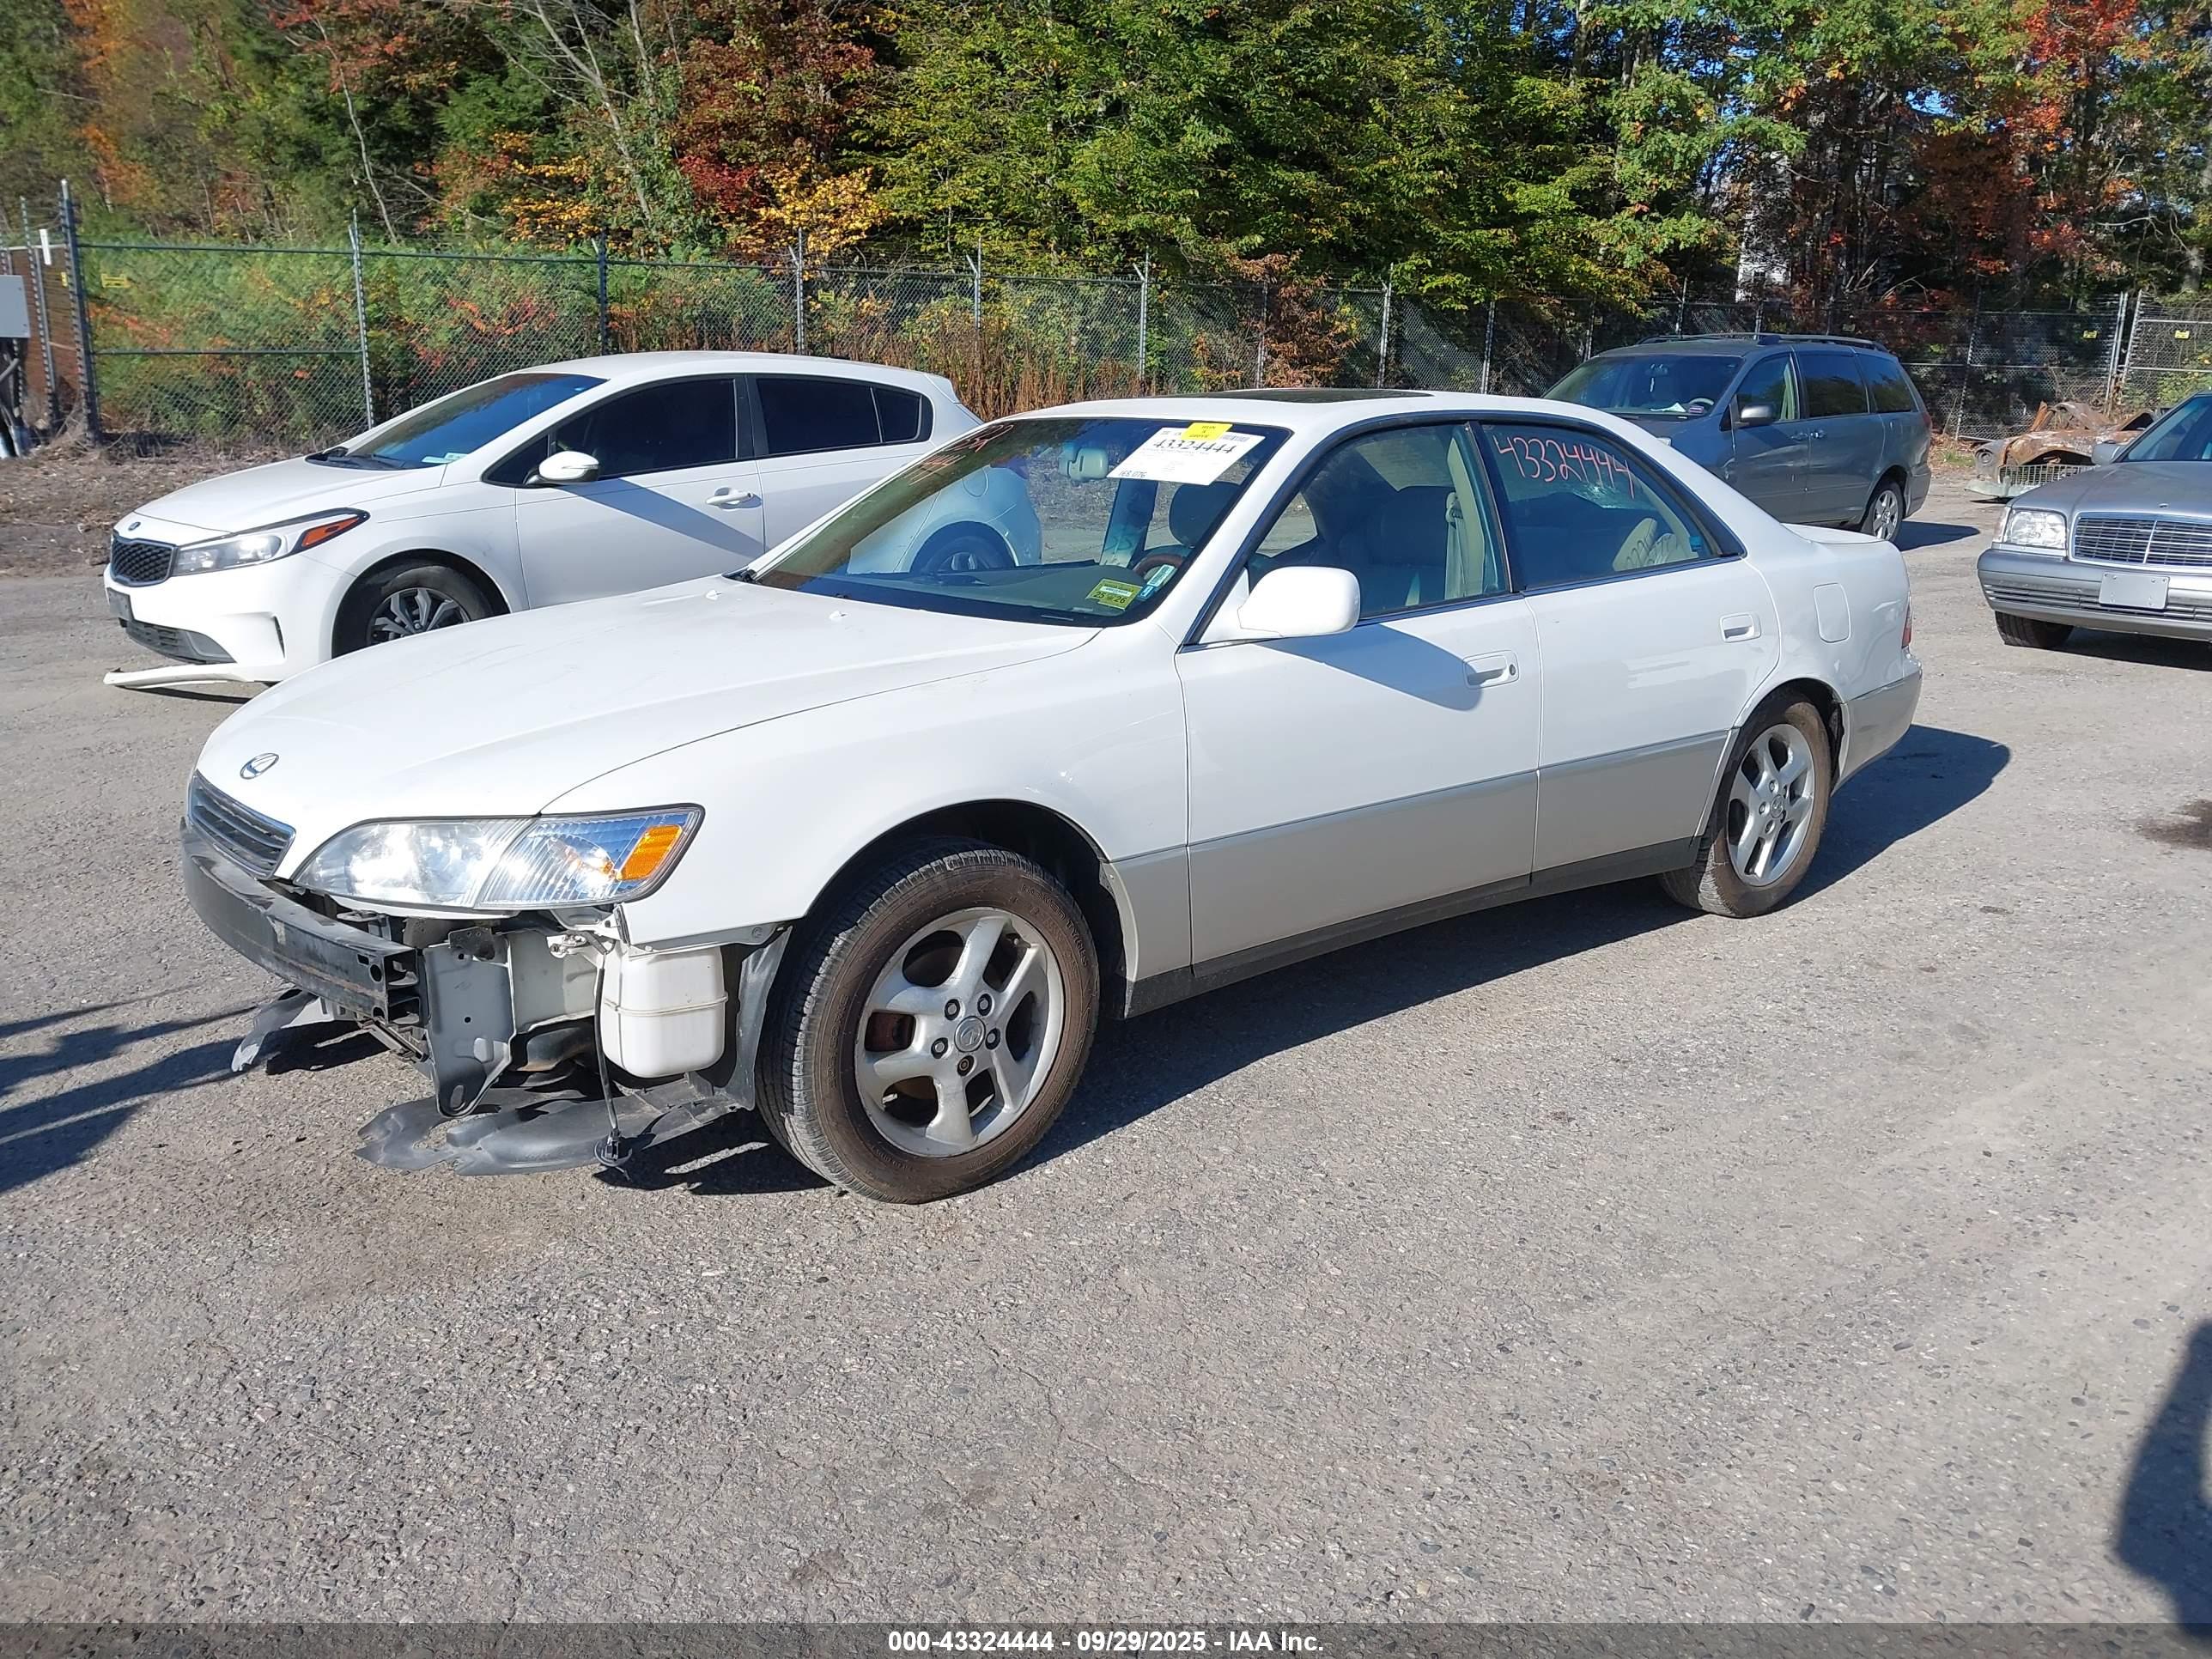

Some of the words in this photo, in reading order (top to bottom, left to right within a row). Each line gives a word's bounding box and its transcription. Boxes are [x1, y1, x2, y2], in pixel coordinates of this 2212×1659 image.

[1152, 439, 1237, 454] 43324444
[1492, 434, 1634, 499] 43324444
[1093, 591, 1107, 599] 25
[1113, 595, 1127, 604] 26
